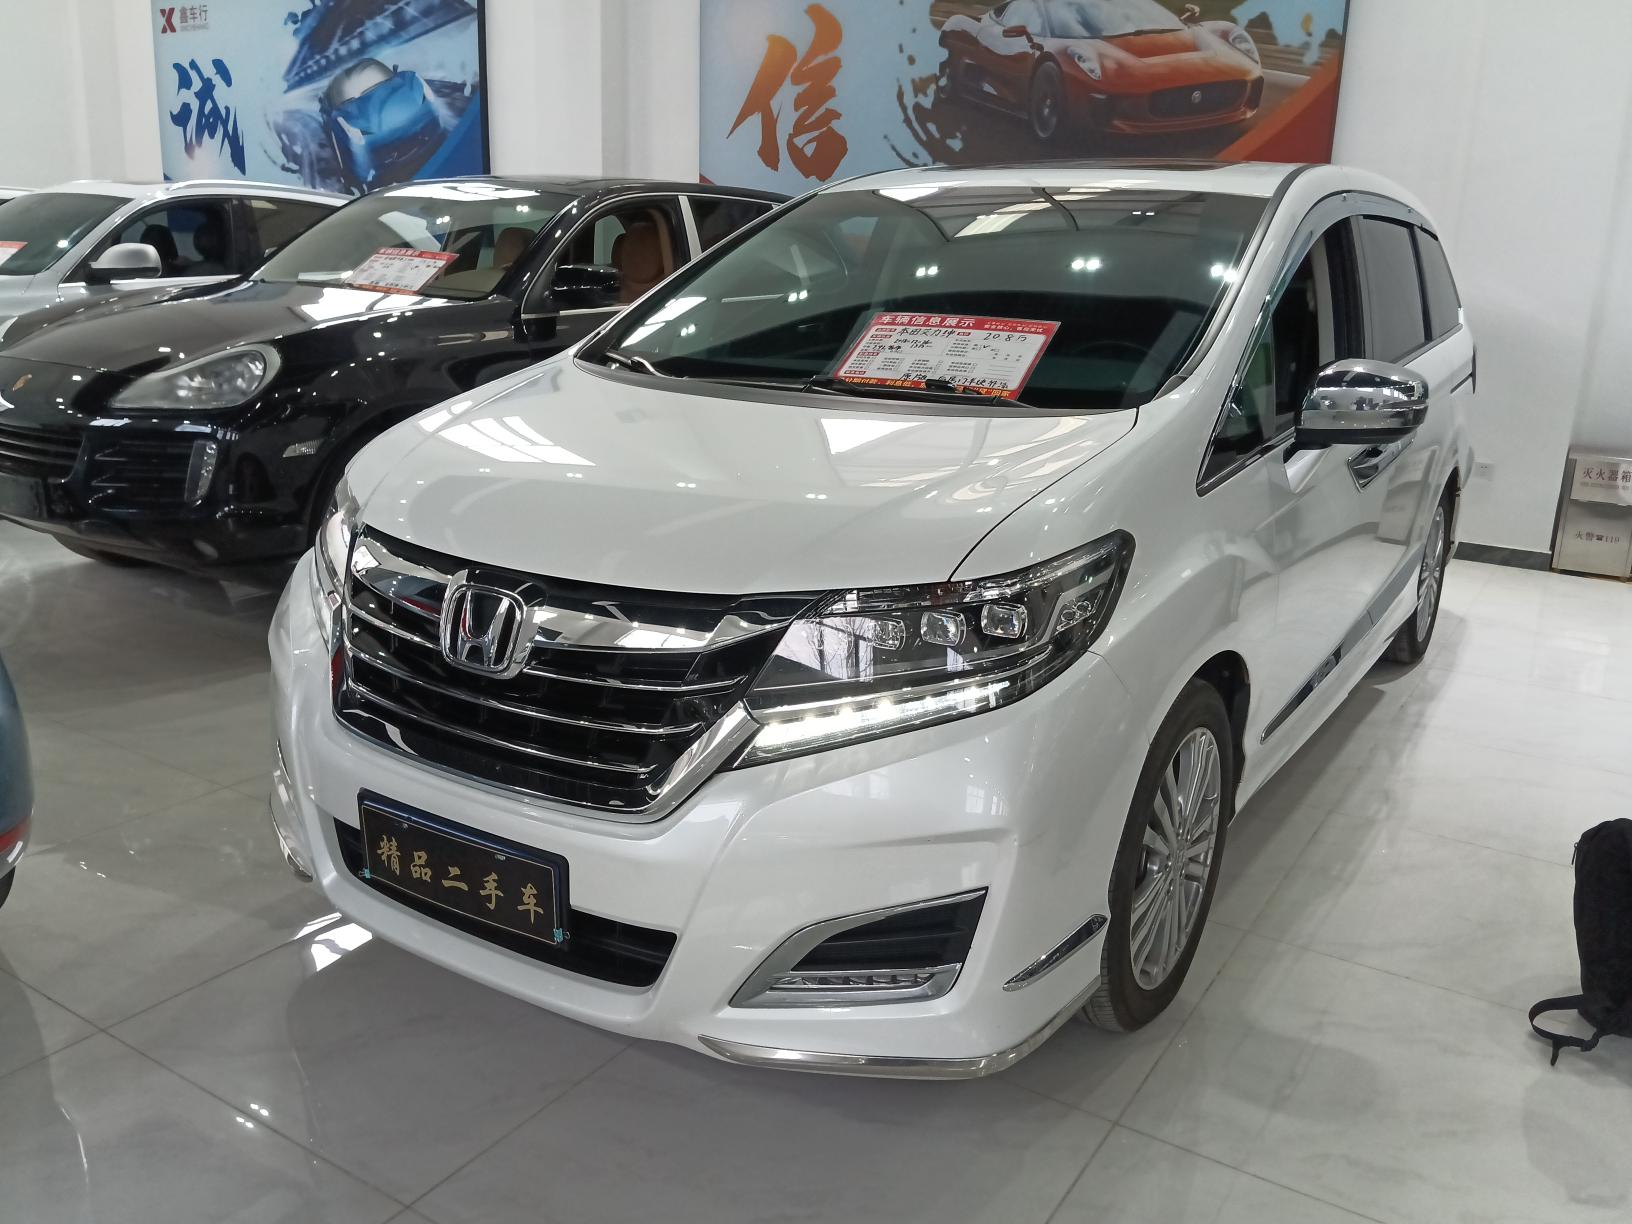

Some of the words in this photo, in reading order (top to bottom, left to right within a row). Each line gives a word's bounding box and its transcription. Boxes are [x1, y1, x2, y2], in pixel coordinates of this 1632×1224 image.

[179, 4, 209, 24] 鑫车行
[169, 58, 246, 176] 诚
[726, 3, 848, 182] 信
[879, 314, 976, 328] 车辆信息展示
[1583, 467, 1632, 483] 灭火器箱
[377, 834, 544, 925] 精品二手车
